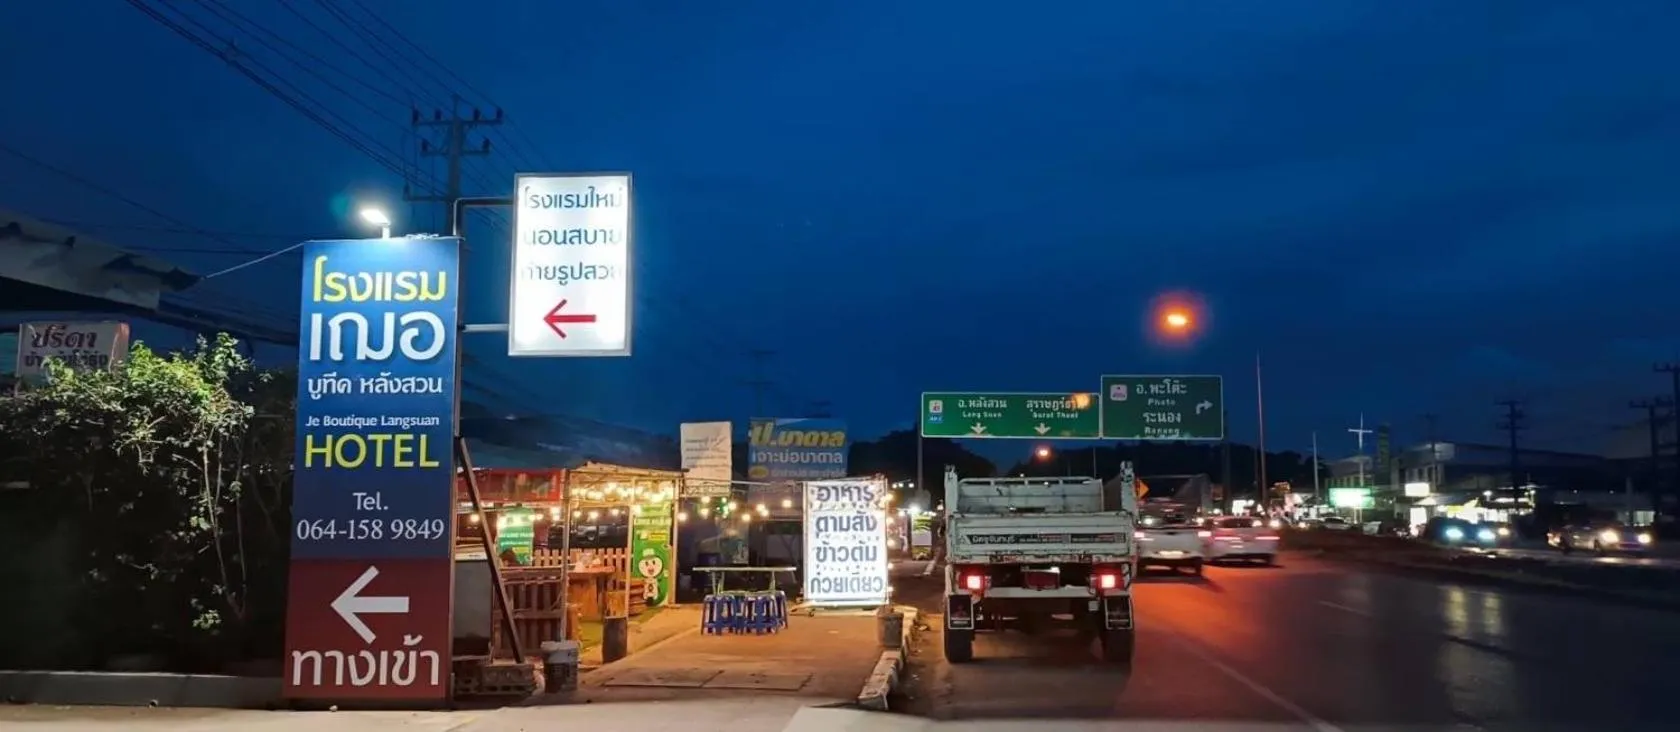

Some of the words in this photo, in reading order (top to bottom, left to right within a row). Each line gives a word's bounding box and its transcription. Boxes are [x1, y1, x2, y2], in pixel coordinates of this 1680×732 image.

[524, 185, 623, 209] โรงแรมใหม่
[312, 255, 447, 302] โรงแรม
[309, 310, 446, 362] เฌอ
[307, 371, 352, 400] บูทีค
[359, 371, 443, 395] หลังสวน
[305, 415, 320, 427] Je
[323, 414, 378, 430] Boutique
[381, 415, 440, 430] Langsuan
[1142, 411, 1182, 423] ระนอง
[305, 433, 440, 468] HOTEL
[352, 491, 389, 511] Tel.
[816, 485, 875, 502] อาหาร
[296, 518, 383, 540] 064-158
[390, 518, 445, 540] 9849
[815, 540, 878, 563] ข้าวต้ม
[291, 634, 440, 686] ทางเข้า
